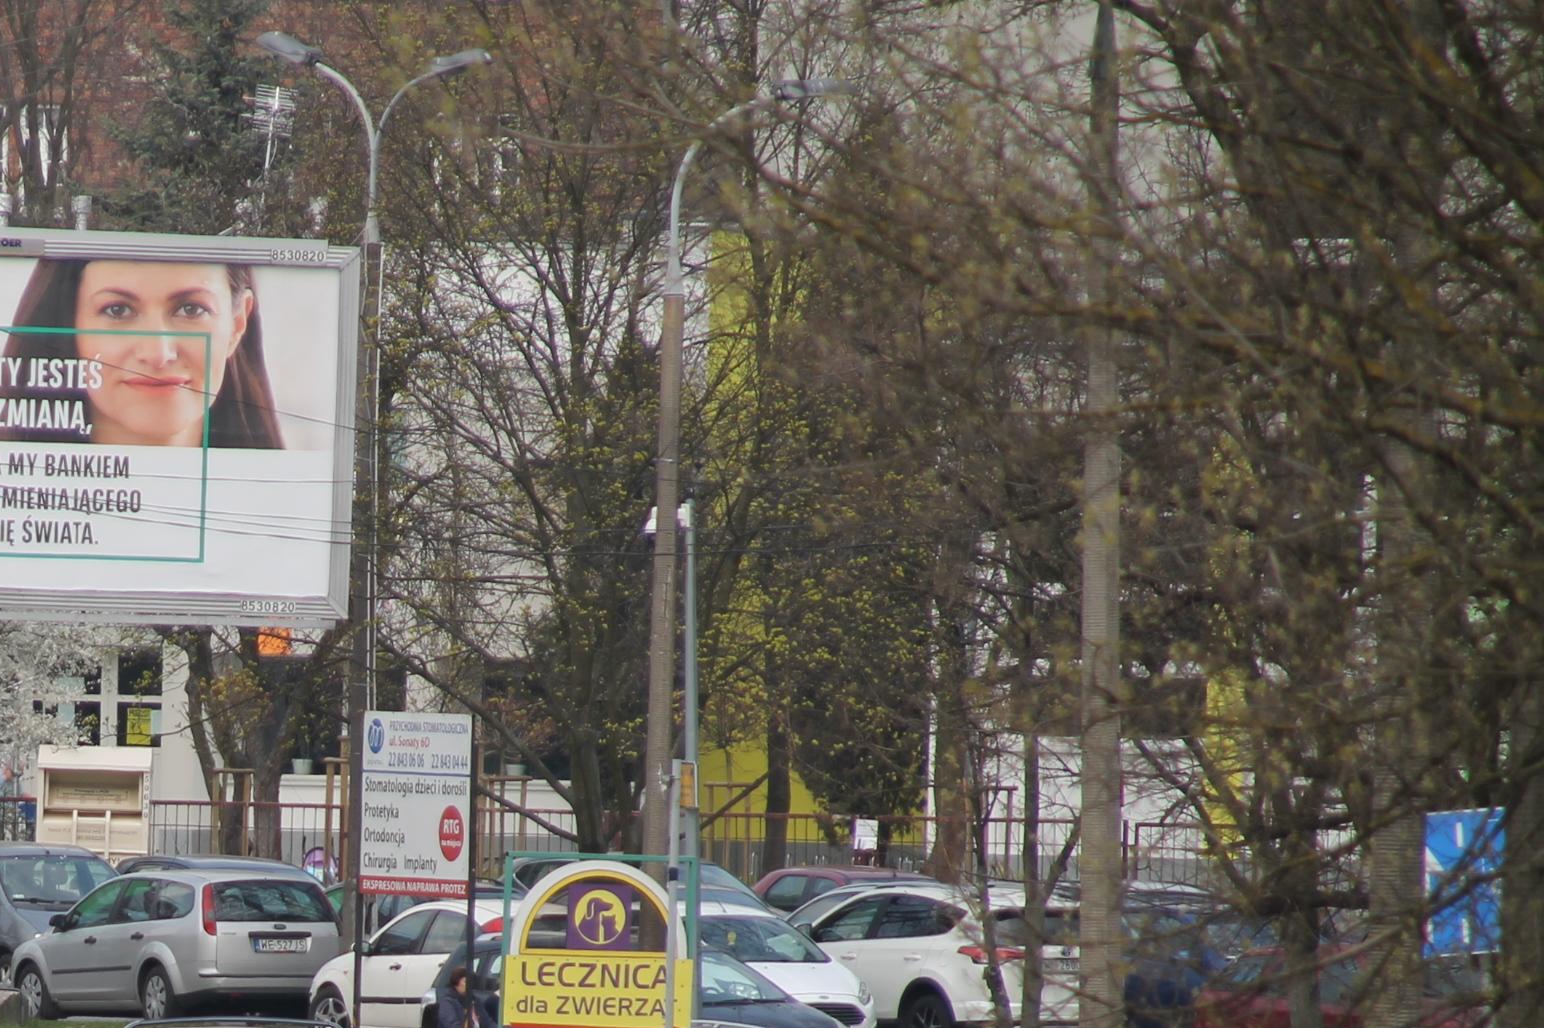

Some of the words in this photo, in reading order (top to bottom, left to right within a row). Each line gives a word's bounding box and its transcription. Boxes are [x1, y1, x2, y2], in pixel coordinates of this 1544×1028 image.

[271, 249, 325, 263] 8530820
[26, 353, 103, 390] JESTEŚ
[7, 452, 38, 477] MY
[44, 453, 130, 479] BANKIEM
[22, 514, 99, 546] ŚWIATA.
[241, 600, 295, 613] 8530820
[387, 752, 396, 768] 22
[431, 753, 439, 769] 22
[364, 776, 413, 798] Stomatologia
[415, 777, 437, 795] dzieci
[364, 802, 400, 823] Protetyka
[363, 826, 406, 848] Ortodoncja
[443, 818, 460, 835] RTG
[363, 852, 398, 873] Chirurgia
[403, 854, 438, 875] Implanty
[362, 879, 406, 892] EKSPRESOWA
[406, 881, 439, 893] NAPRAWA
[440, 883, 467, 895] PROTEZ
[521, 961, 666, 990] LECZNICA
[515, 995, 548, 1014] dla
